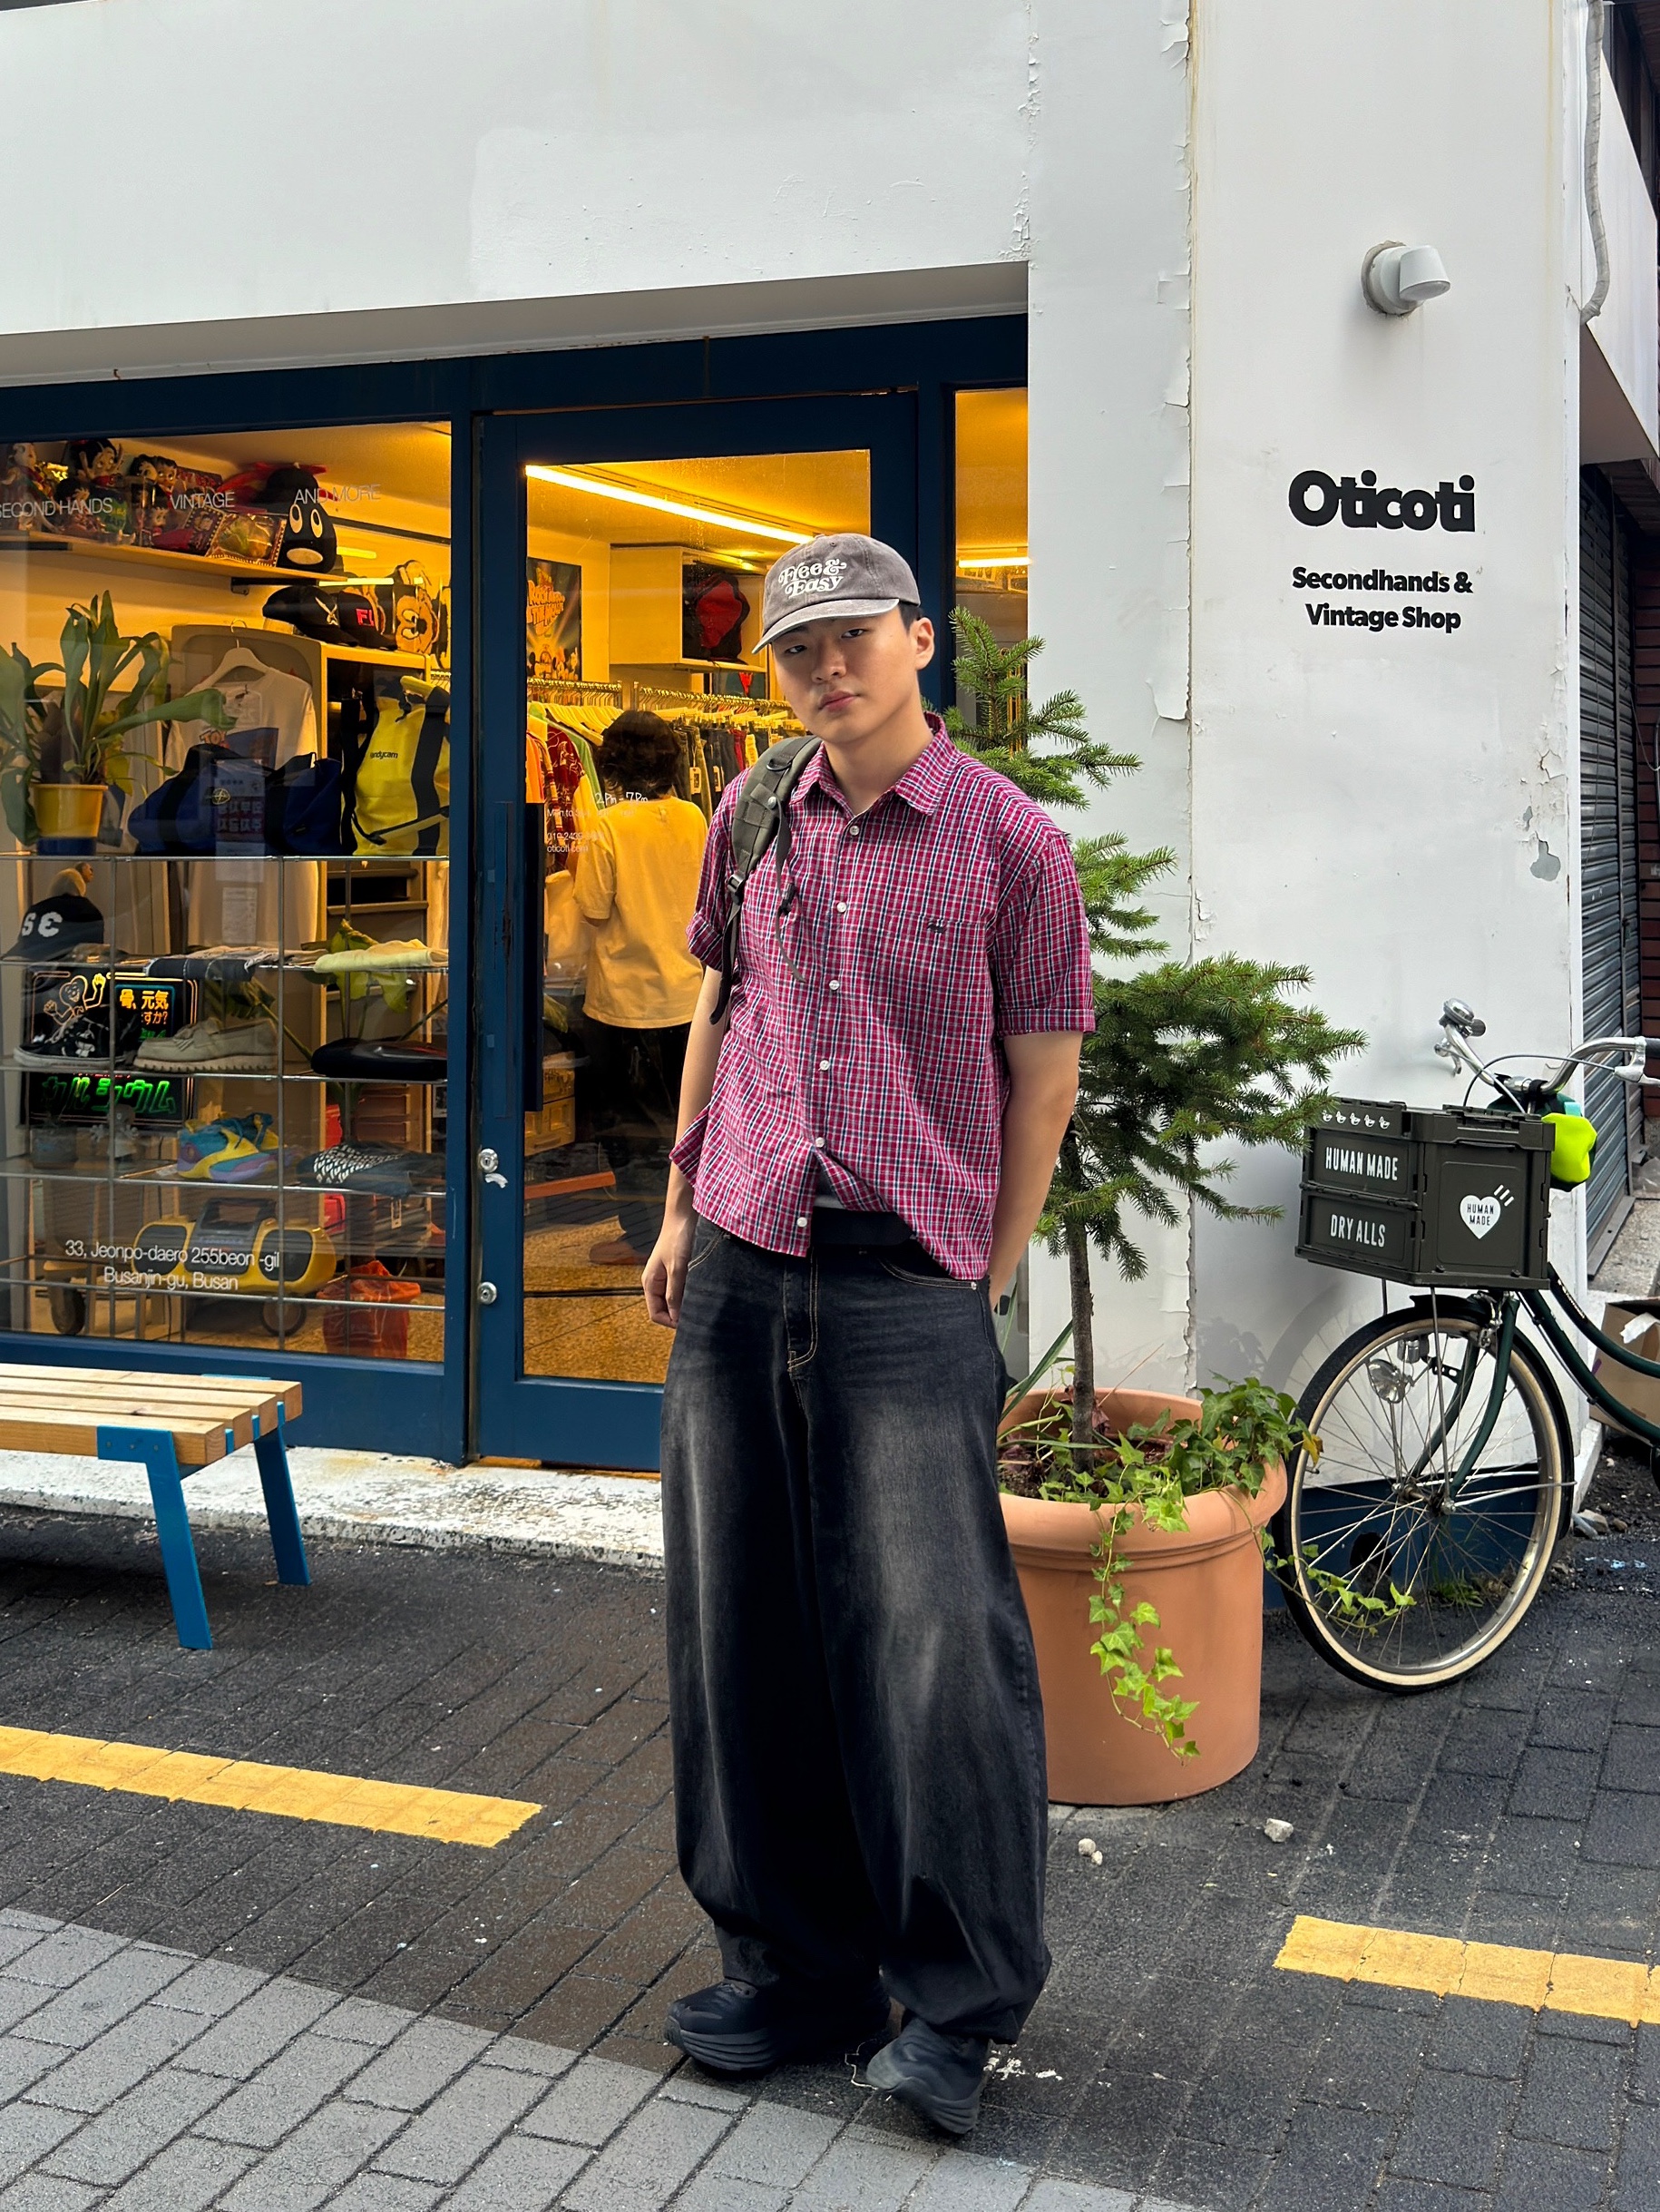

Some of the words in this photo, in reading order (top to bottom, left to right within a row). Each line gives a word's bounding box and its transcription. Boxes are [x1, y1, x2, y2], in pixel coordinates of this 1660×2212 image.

[170, 491, 236, 510] VINTAGE
[295, 487, 328, 505] AND
[332, 484, 381, 502] MORE
[1288, 469, 1476, 533] Oticoti
[0, 500, 55, 519] ECOND
[59, 497, 113, 515] HANDS
[785, 575, 845, 599] Easy
[1292, 566, 1450, 592] Secondhands
[1453, 571, 1474, 593] &
[1304, 602, 1399, 632] Vintage
[1402, 606, 1461, 633] Shop
[141, 1011, 169, 1025] すか?
[1325, 1146, 1363, 1176] HUMAN
[1366, 1152, 1399, 1181] MADE
[1467, 1203, 1495, 1215] HUMAN
[1470, 1215, 1491, 1227] MADE
[1330, 1214, 1354, 1241] DRY
[1355, 1219, 1387, 1248] ALLS
[65, 1239, 87, 1258] 33,
[92, 1241, 188, 1264] Jeonpo-daero
[190, 1246, 255, 1267] 255beon
[103, 1267, 189, 1292] Busanjin-gu,
[192, 1271, 239, 1291] Busan
